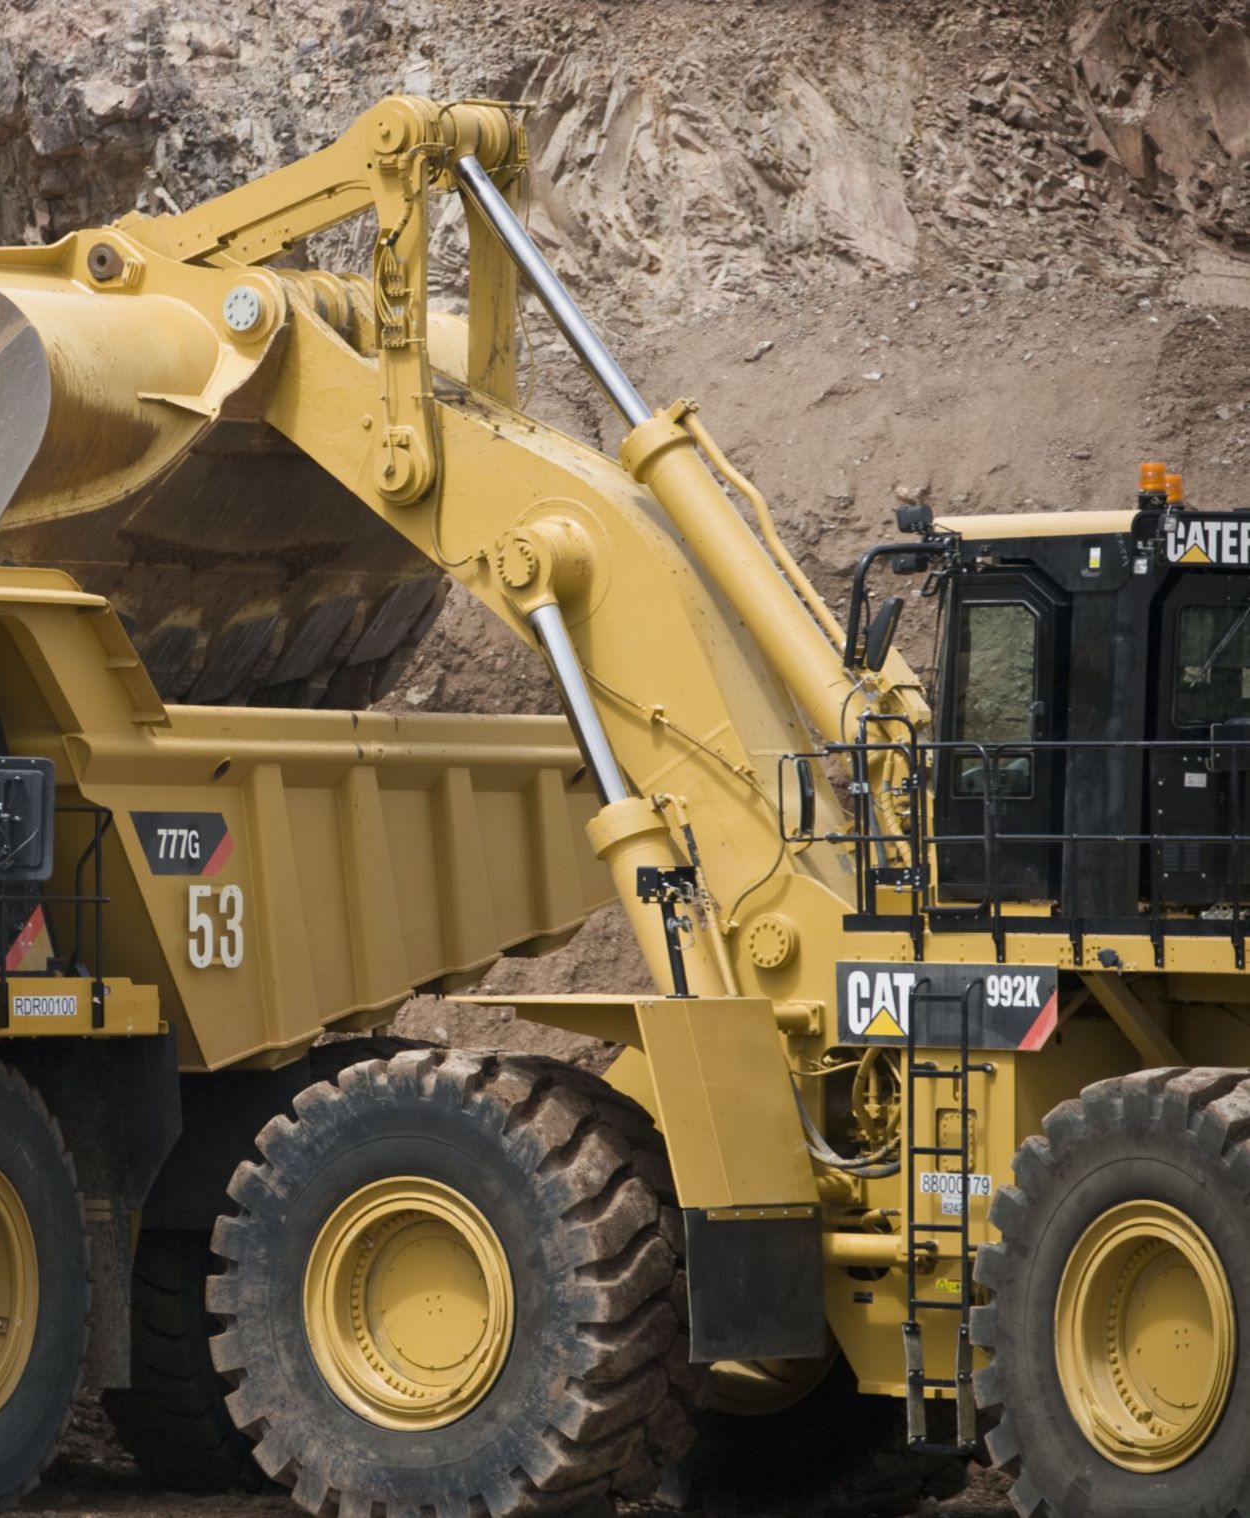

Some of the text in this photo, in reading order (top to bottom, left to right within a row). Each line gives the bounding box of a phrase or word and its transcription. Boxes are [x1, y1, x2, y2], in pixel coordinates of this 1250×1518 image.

[156, 828, 200, 859] 777G
[188, 884, 244, 969] 53
[14, 997, 76, 1016] RDR00100
[847, 970, 916, 1036] CAT
[986, 974, 1041, 1008] 992K
